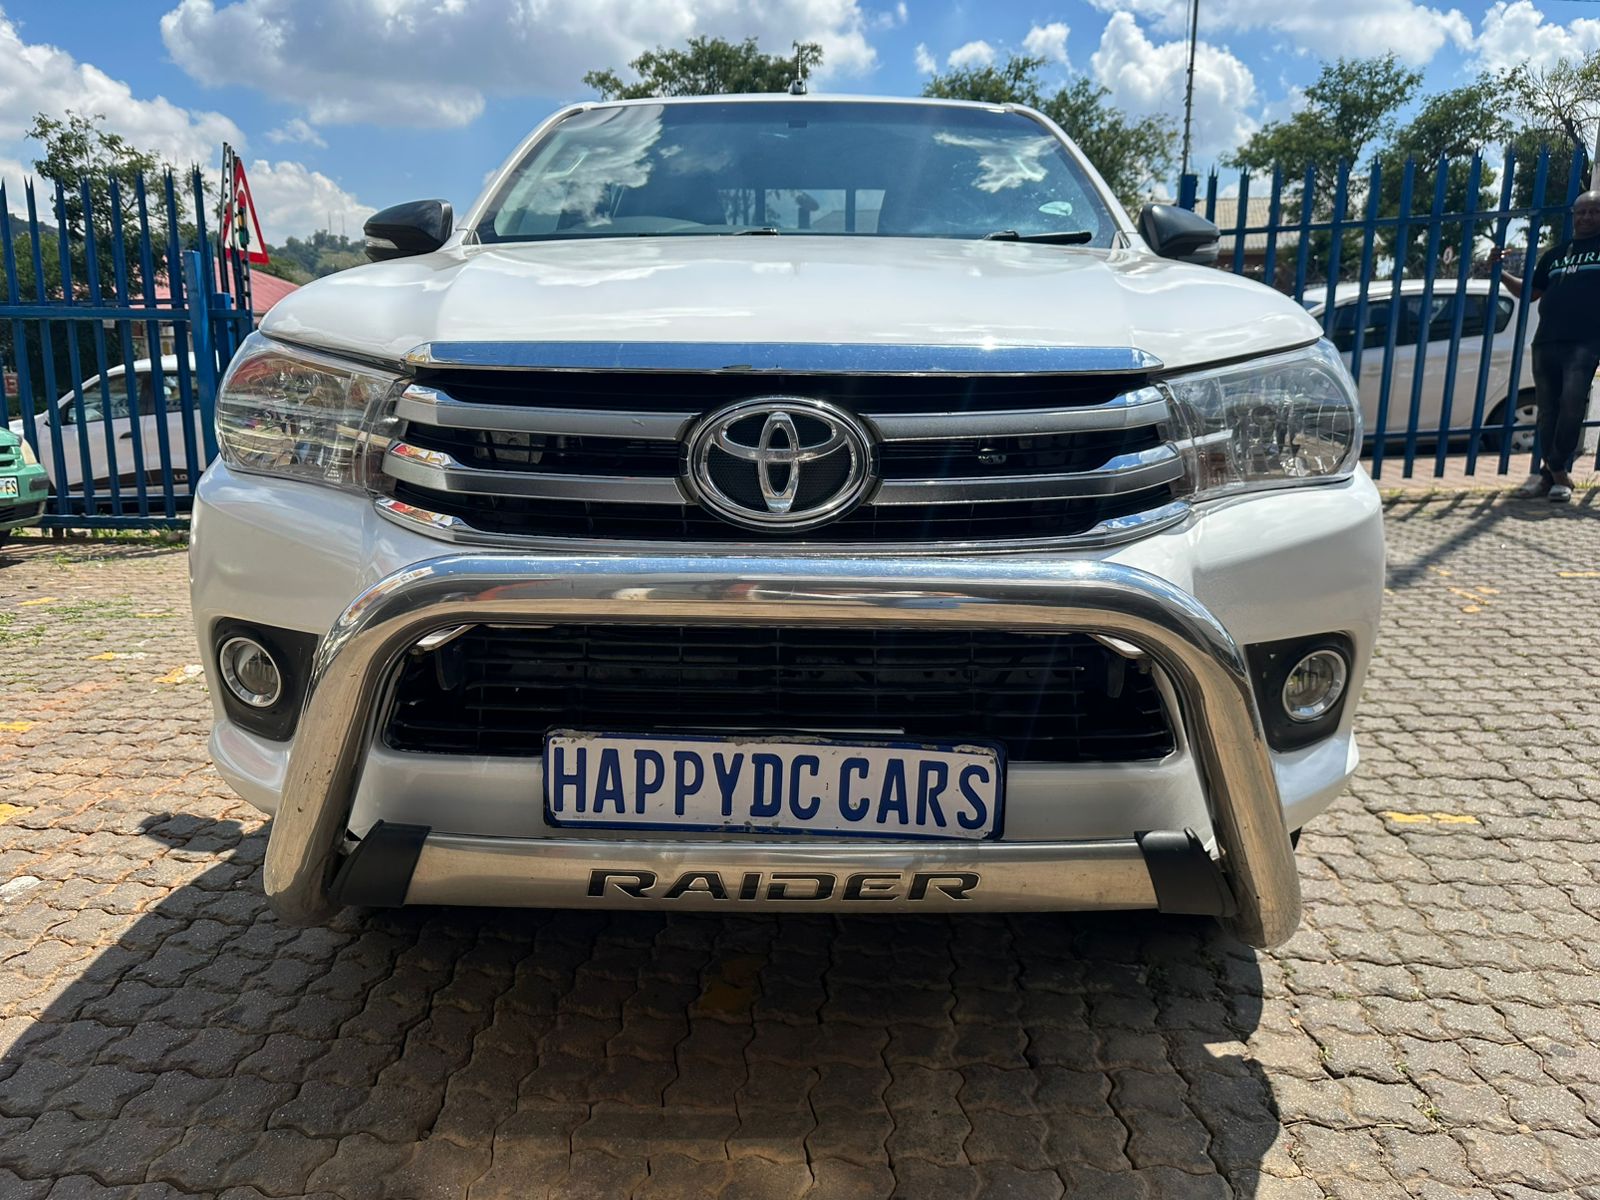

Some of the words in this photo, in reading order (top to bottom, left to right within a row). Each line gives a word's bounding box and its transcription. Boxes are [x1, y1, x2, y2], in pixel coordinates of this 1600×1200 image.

[1550, 251, 1600, 269] AMIR
[553, 747, 819, 820] HAPPYDC
[838, 757, 990, 830] CARS
[587, 869, 981, 901] RAIDER
